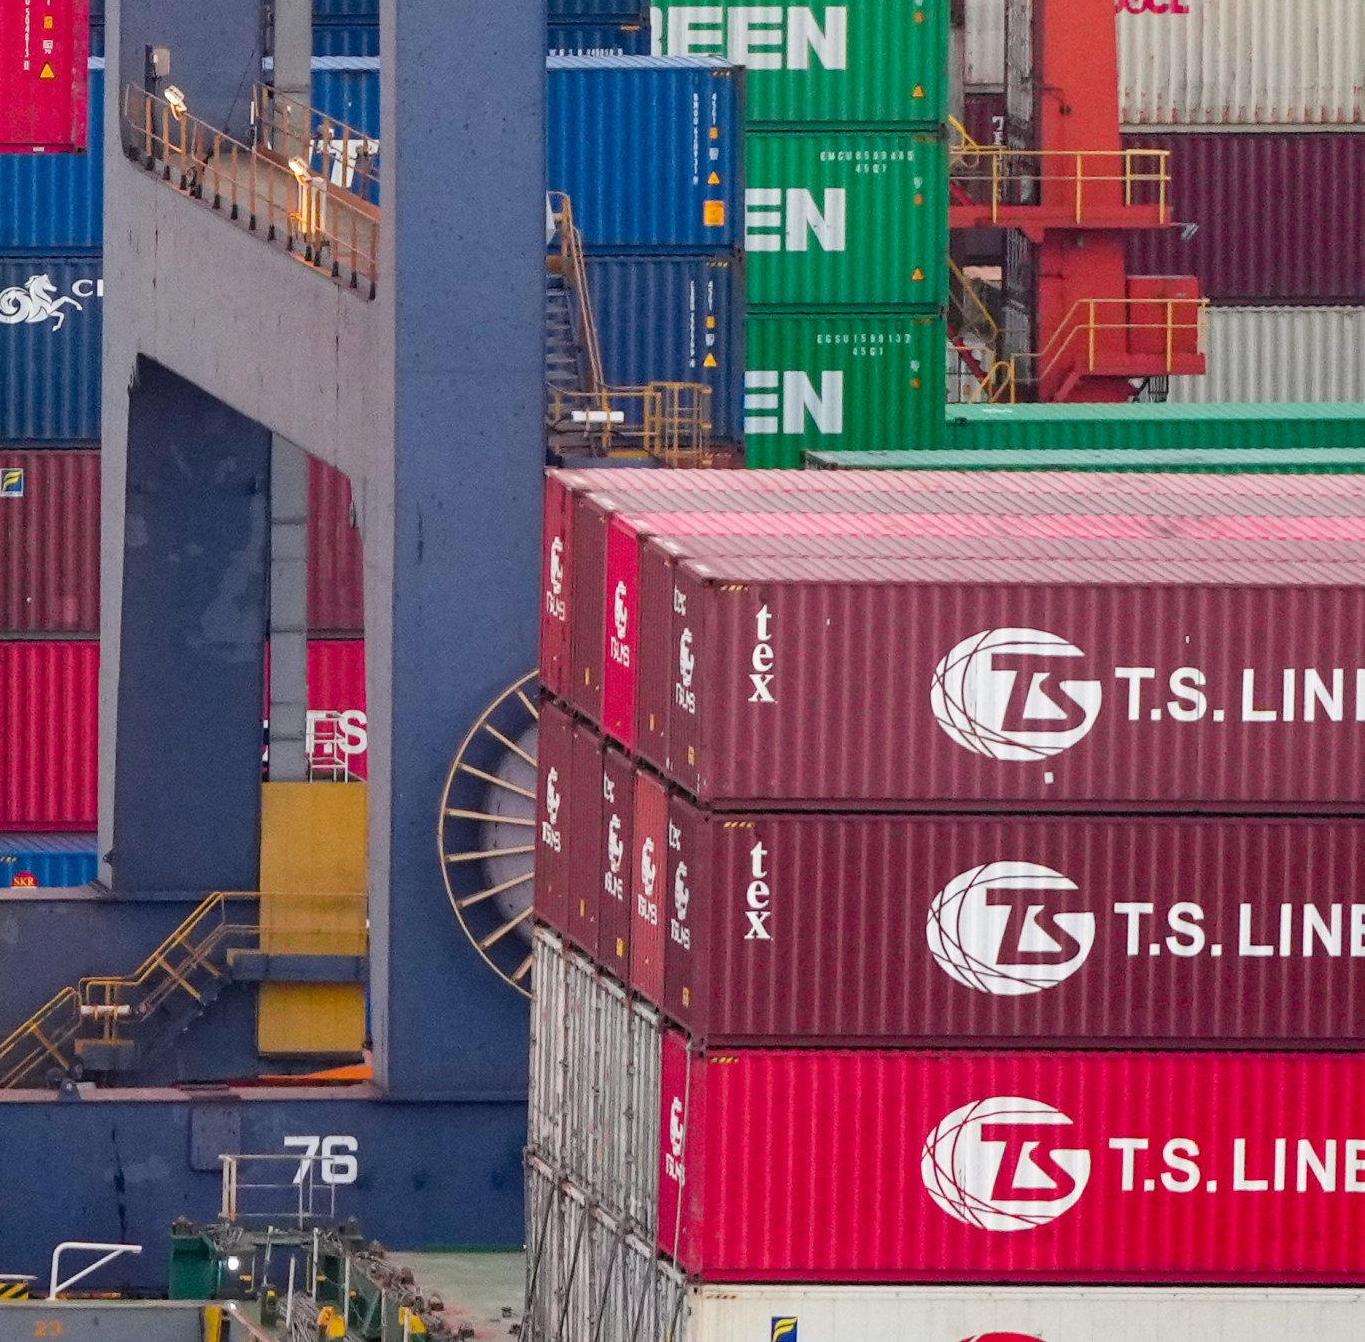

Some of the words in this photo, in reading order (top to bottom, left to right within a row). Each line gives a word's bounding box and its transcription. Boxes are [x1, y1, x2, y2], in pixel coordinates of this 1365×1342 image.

[748, 604, 776, 703] tex
[1114, 665, 1225, 723] T.S.
[744, 841, 773, 942] tex
[1113, 900, 1222, 958] T.S.
[283, 1134, 359, 1185] 76
[1108, 1137, 1219, 1193] T.S.
